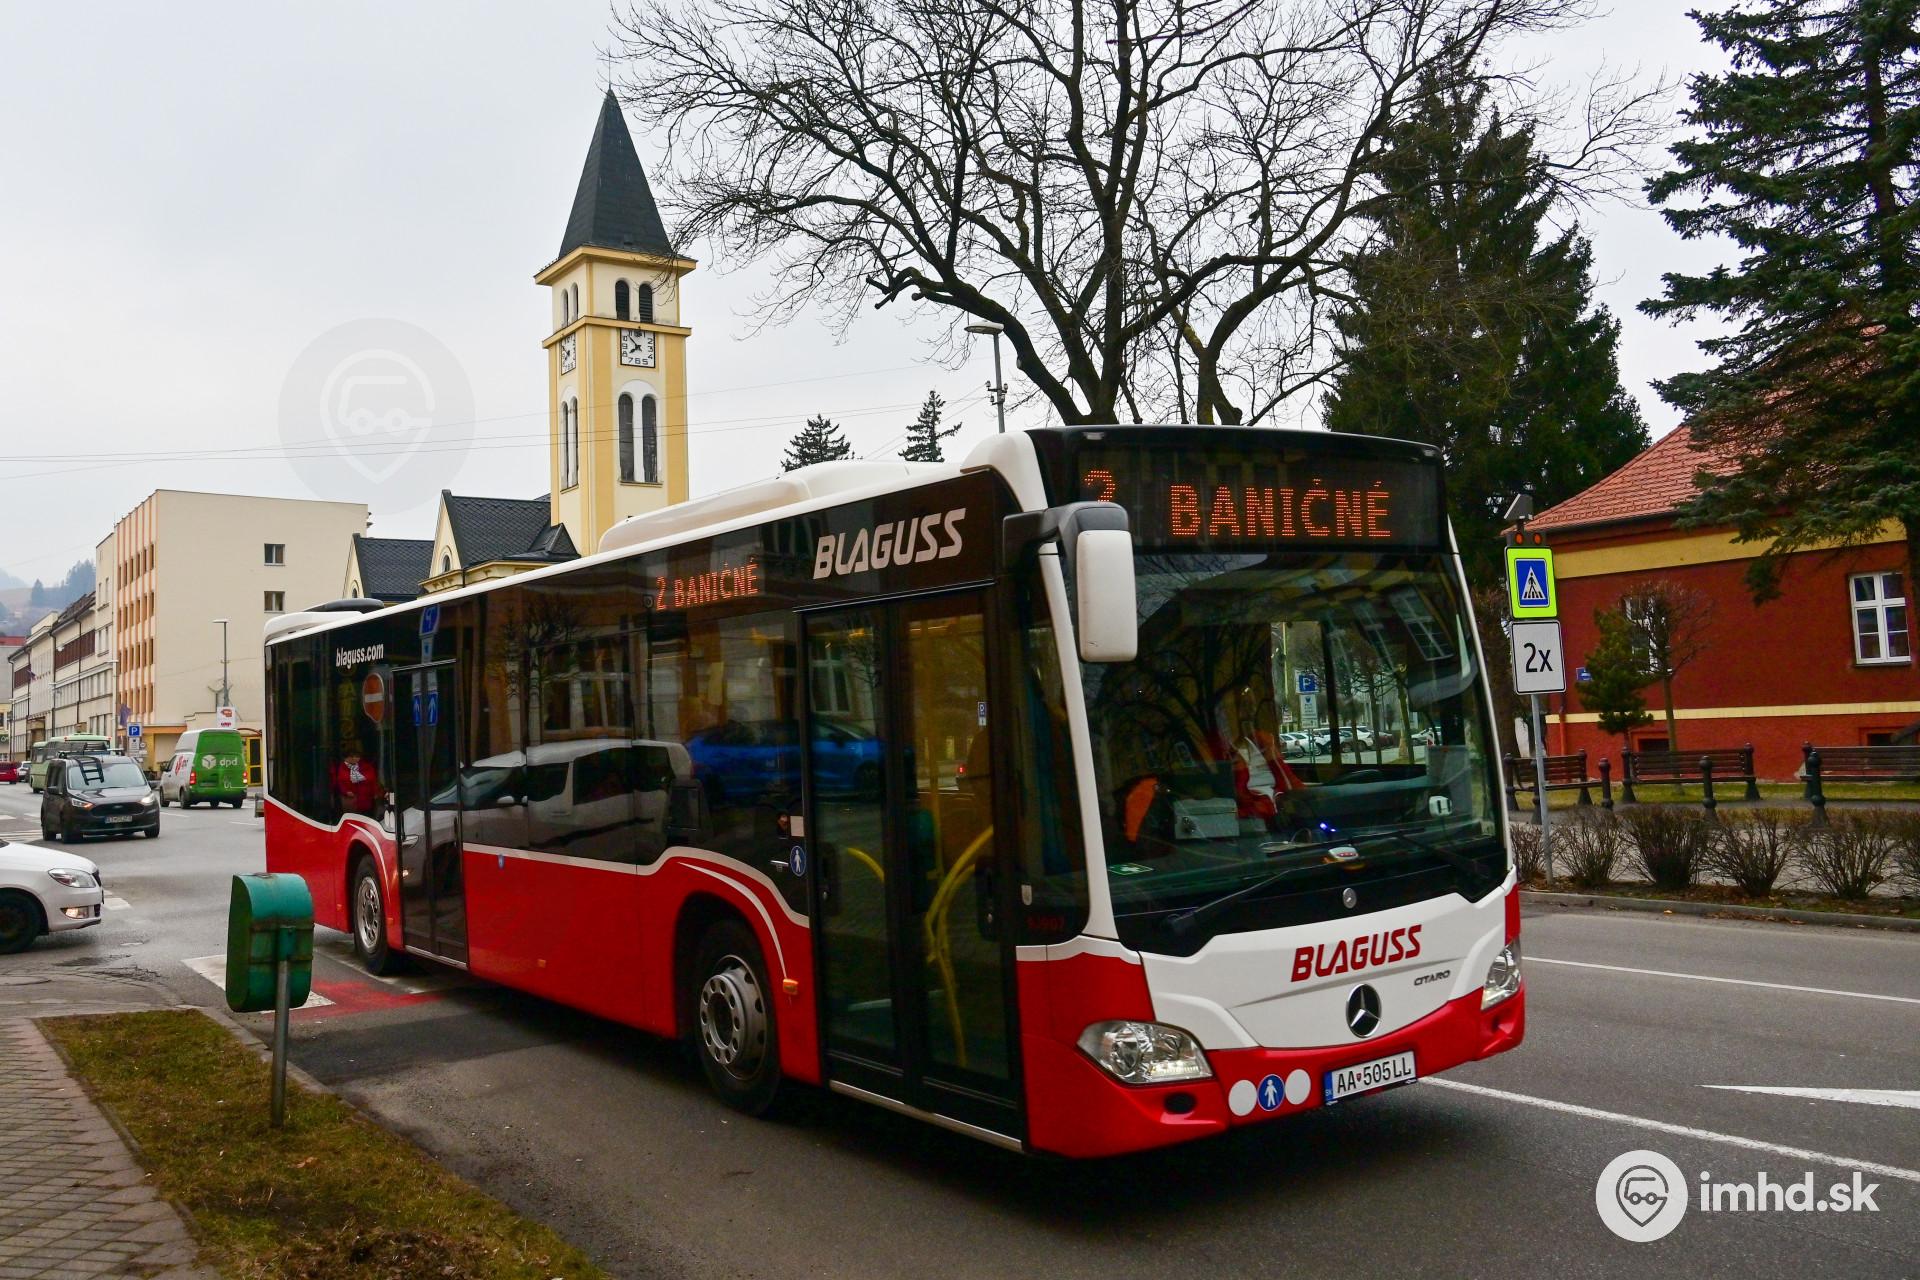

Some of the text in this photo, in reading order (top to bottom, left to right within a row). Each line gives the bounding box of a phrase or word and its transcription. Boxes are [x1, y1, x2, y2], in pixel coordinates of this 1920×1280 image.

[812, 507, 967, 580] BLAGUSS
[655, 575, 667, 611] 2
[335, 643, 384, 670] blaguss.com
[1523, 642, 1554, 673] 2x
[131, 726, 138, 735] P
[219, 757, 238, 768] dpd
[1290, 924, 1422, 983] BLAGUSS
[1413, 969, 1451, 987] CITARO
